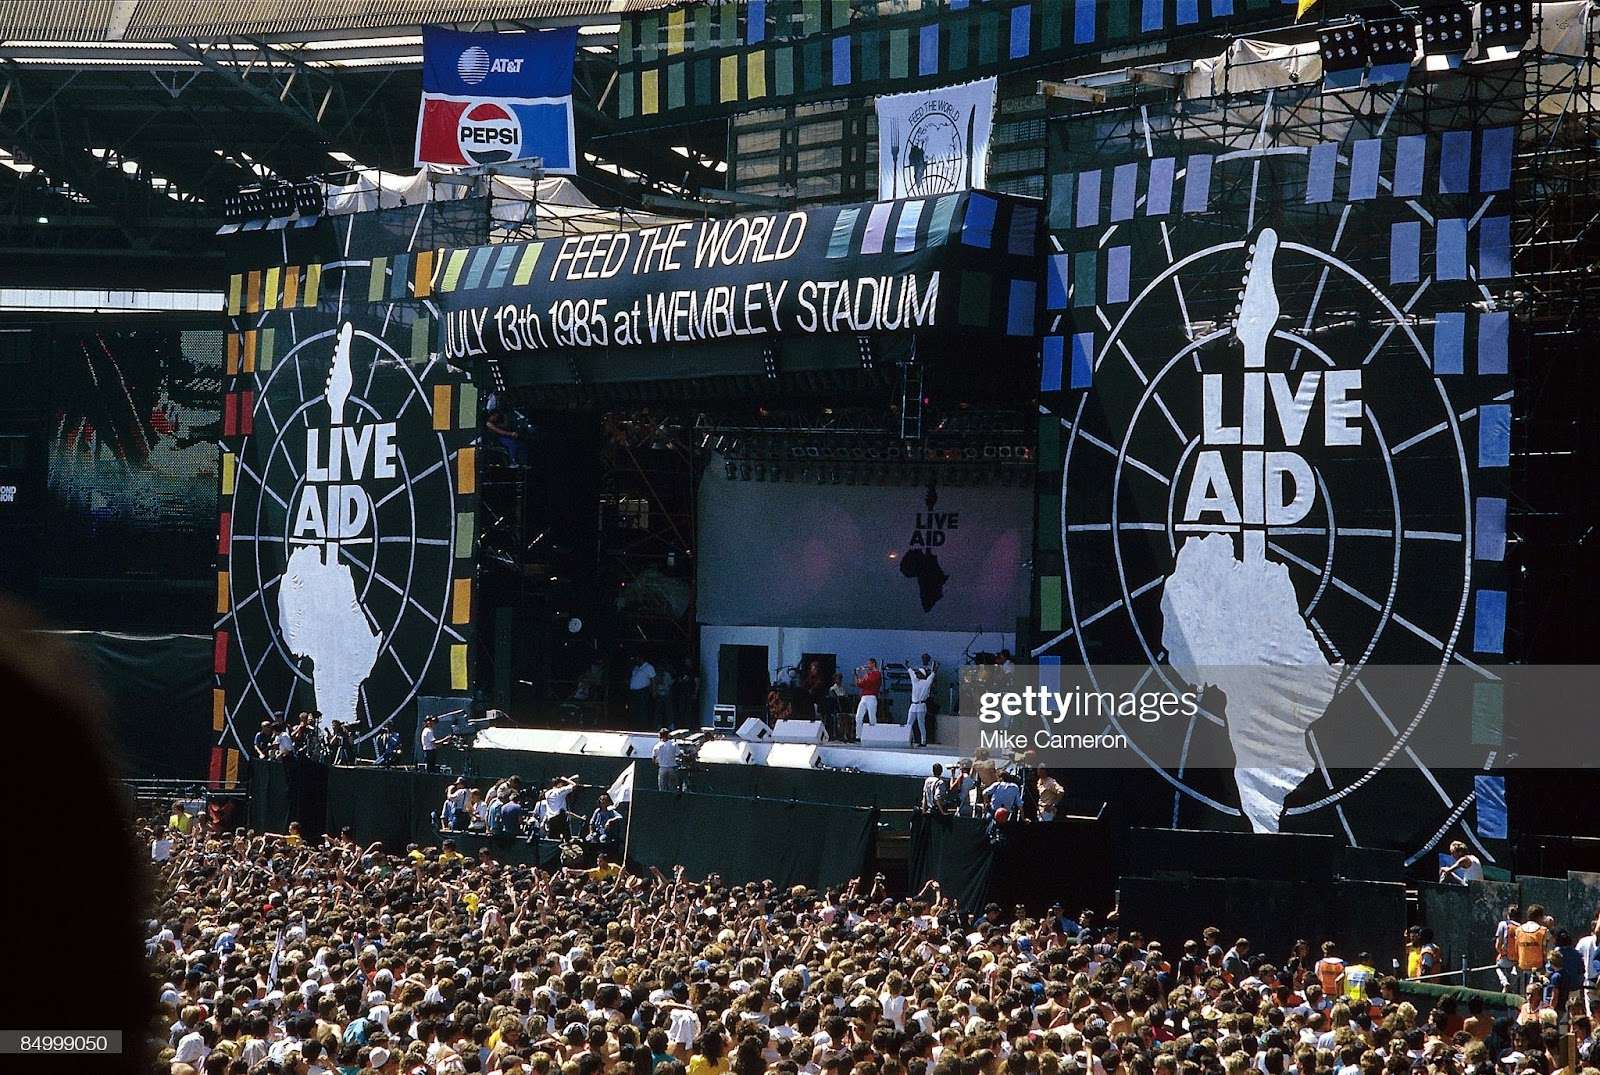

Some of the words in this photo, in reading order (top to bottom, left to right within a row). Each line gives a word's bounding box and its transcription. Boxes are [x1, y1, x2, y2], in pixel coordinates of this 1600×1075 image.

[490, 58, 524, 73] AT&T
[460, 126, 519, 145] PEPSI
[908, 106, 926, 126] FEED
[923, 100, 937, 111] THE
[938, 100, 960, 122] WORLD
[550, 232, 631, 282] FEED
[632, 222, 693, 275] THE
[694, 211, 808, 270] WORLD
[444, 306, 489, 359] JULY
[494, 303, 549, 352] 13th
[548, 298, 609, 347] 1985
[613, 300, 642, 346] at
[647, 279, 789, 344] WEMBLEY
[796, 270, 941, 333] STADIUM
[1202, 369, 1363, 447] LIVE
[306, 421, 397, 482] LIVE
[293, 484, 369, 539] AID
[1183, 450, 1316, 526] AID
[909, 530, 946, 547] AID
[915, 512, 960, 530] LIVE
